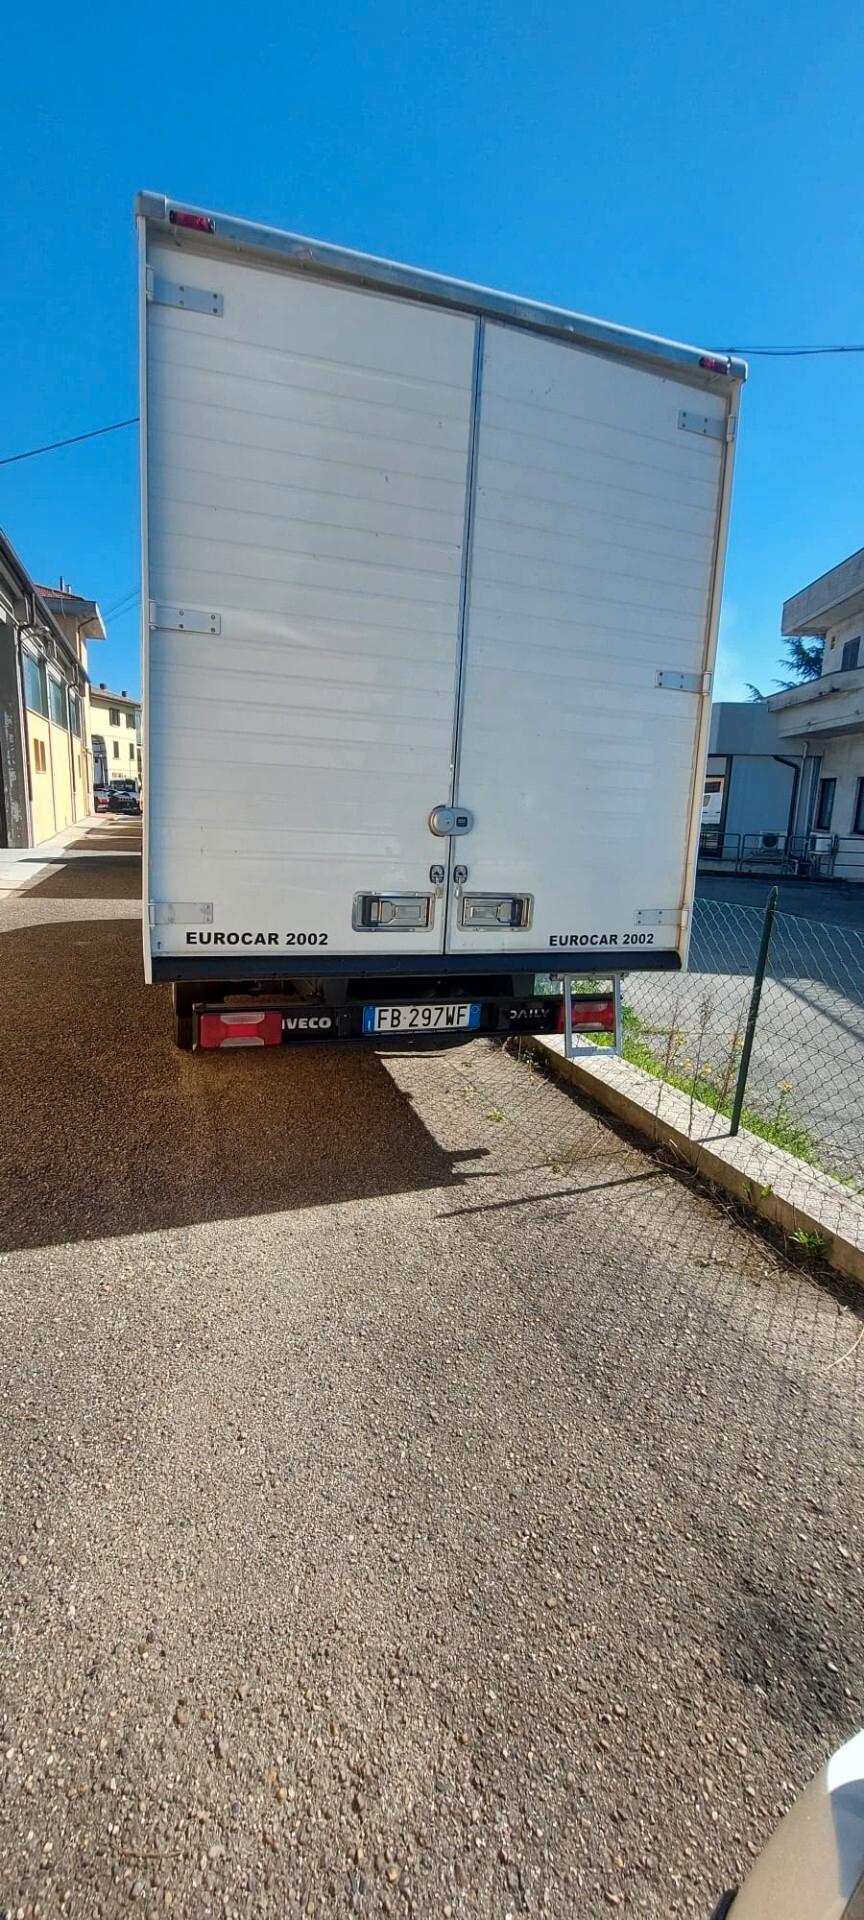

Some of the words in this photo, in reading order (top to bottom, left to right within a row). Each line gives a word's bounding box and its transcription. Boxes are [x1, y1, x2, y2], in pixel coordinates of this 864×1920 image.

[185, 931, 279, 945] EUROCAR
[286, 932, 329, 946] 2002
[549, 934, 618, 947] EUROCAR
[622, 933, 655, 945] 2002
[507, 1008, 551, 1020] DAILY
[281, 1017, 332, 1030] IVECO
